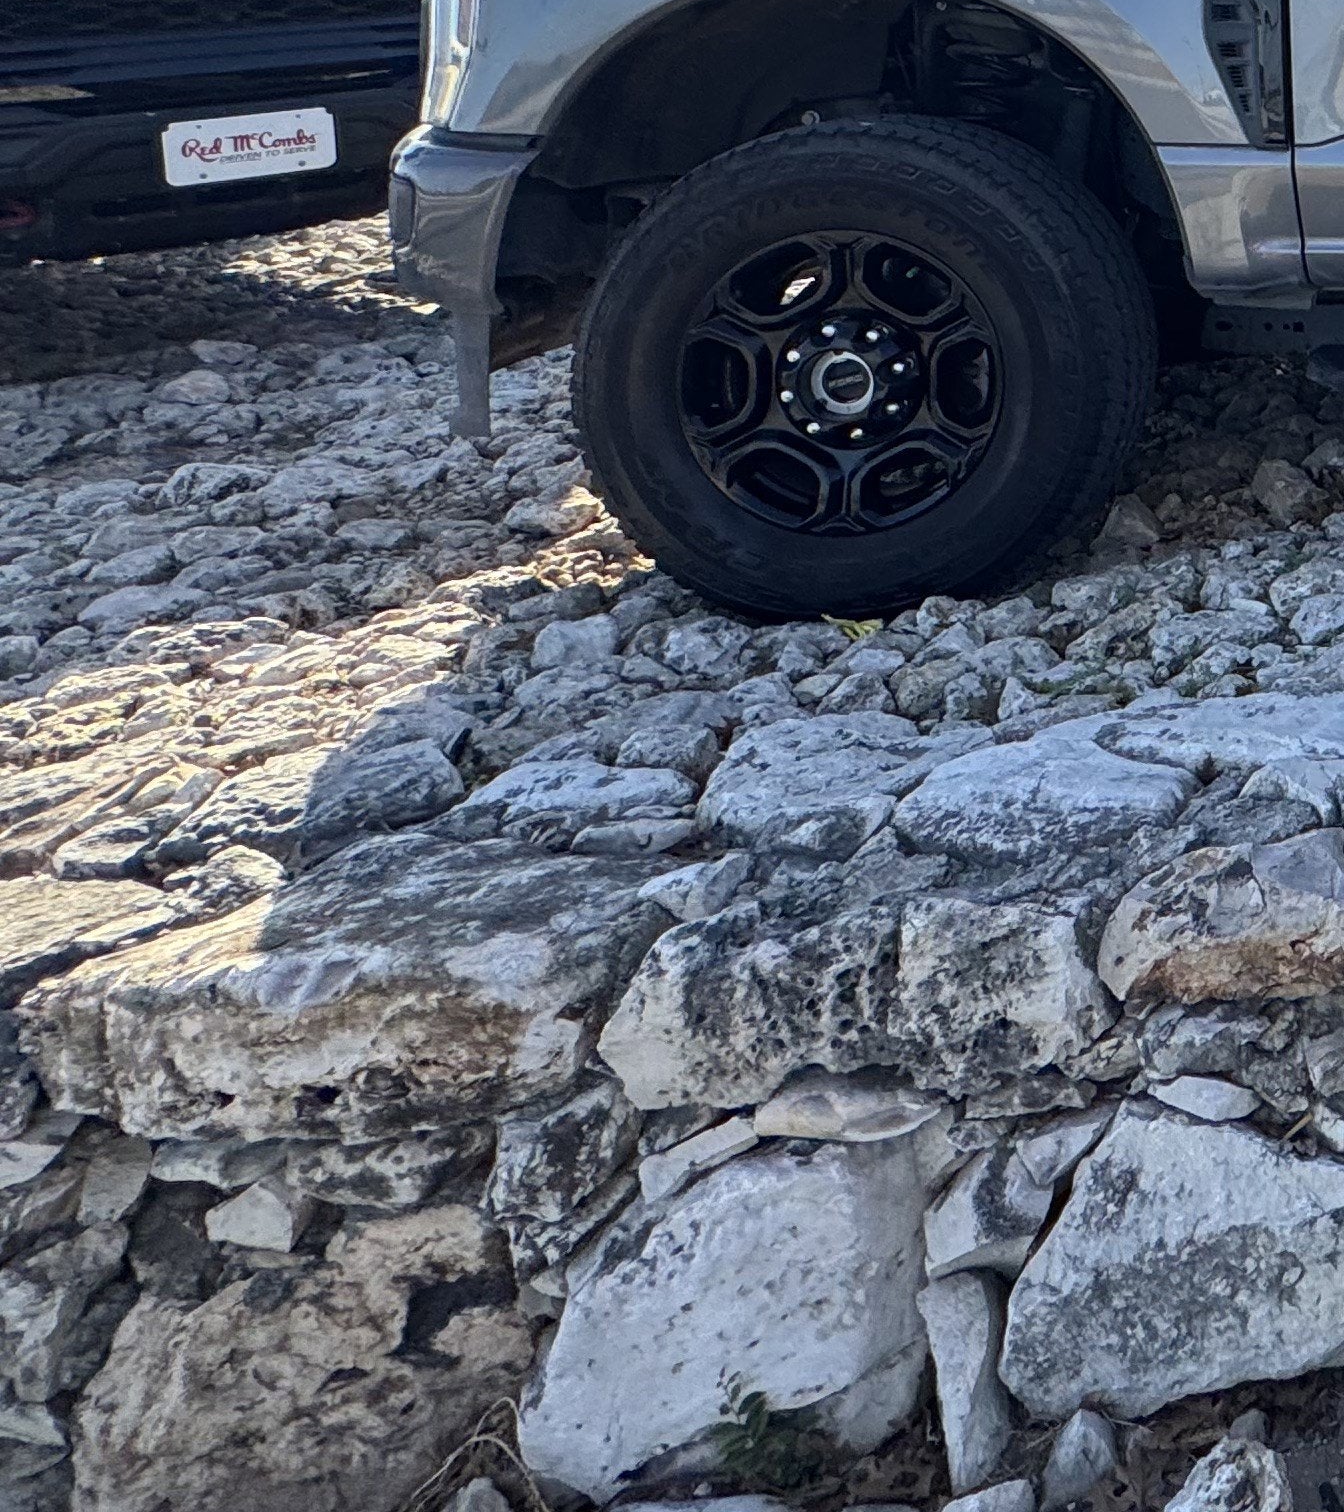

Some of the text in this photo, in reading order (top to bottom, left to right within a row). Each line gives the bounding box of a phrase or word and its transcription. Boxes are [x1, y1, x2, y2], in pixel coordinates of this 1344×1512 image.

[181, 128, 318, 163] Red McCombs
[219, 145, 317, 164] DRIVEN TO SERVE
